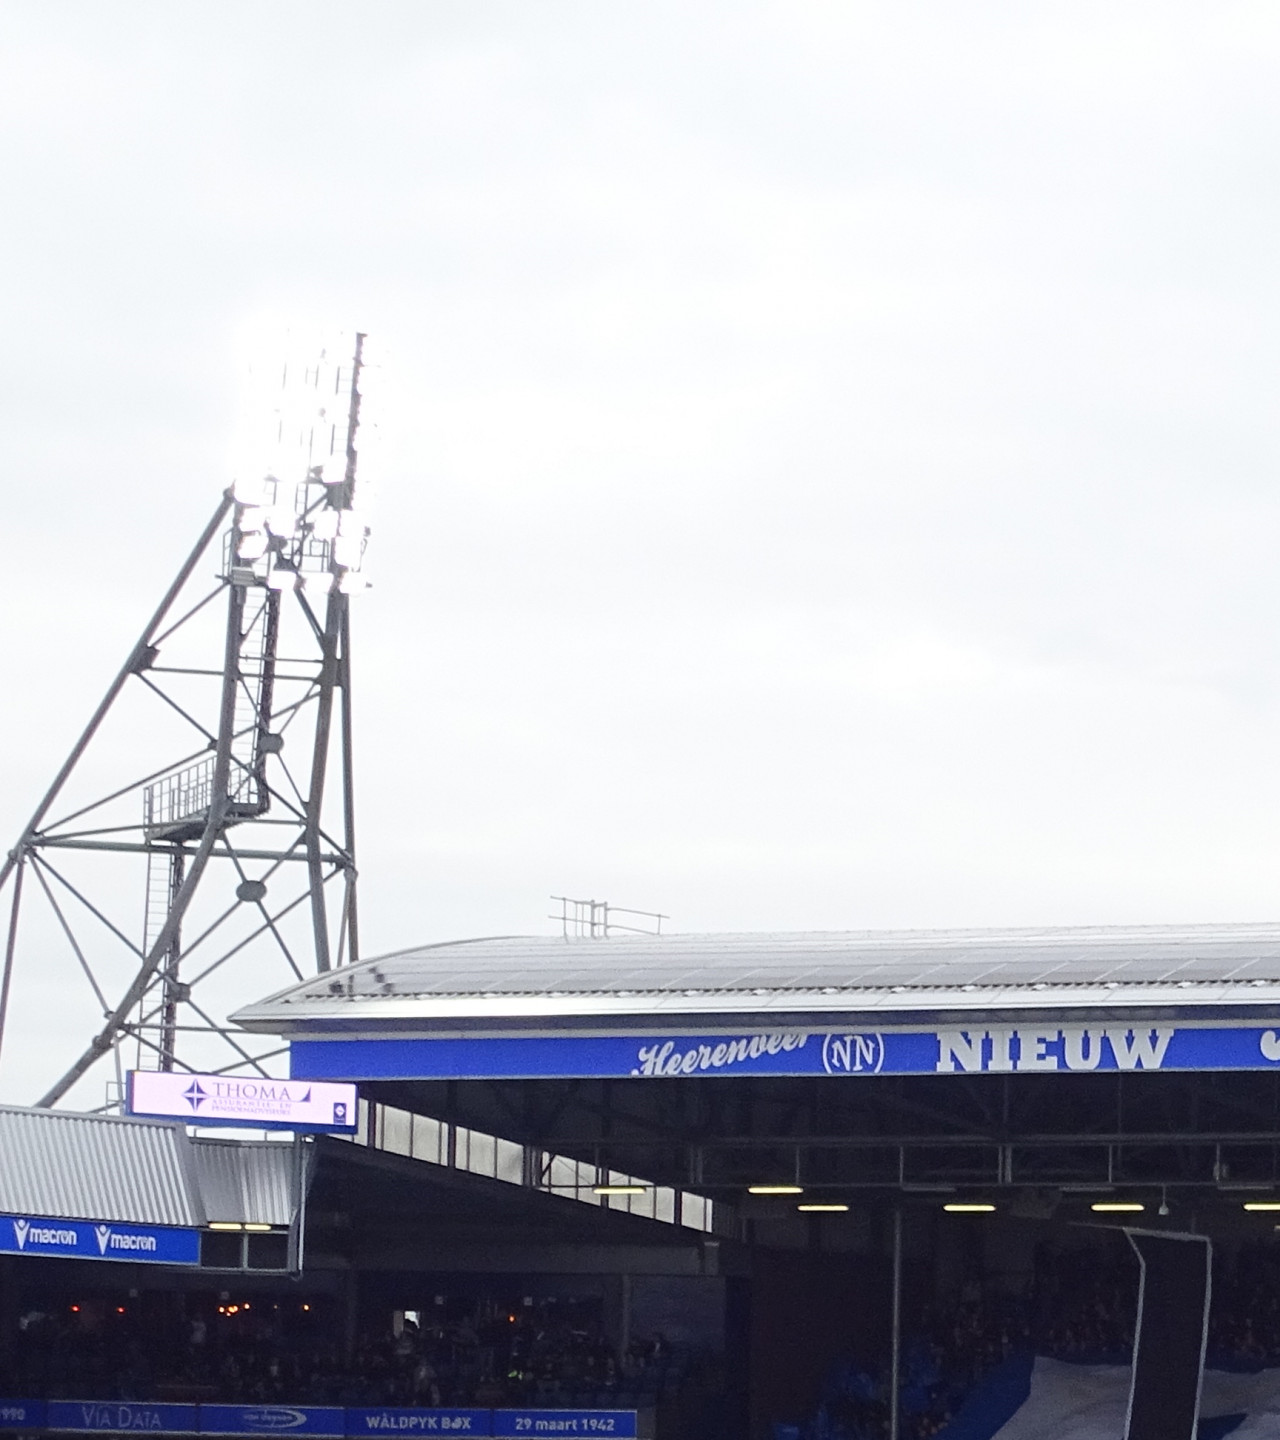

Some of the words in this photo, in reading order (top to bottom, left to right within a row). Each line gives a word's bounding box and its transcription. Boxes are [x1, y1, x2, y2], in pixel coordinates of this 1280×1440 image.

[936, 1029, 1174, 1071] NIEUW
[213, 1082, 292, 1101] THOMA
[30, 1228, 77, 1245] macron
[111, 1233, 156, 1251] macron
[516, 1418, 532, 1431] 29
[535, 1418, 578, 1431] maart
[582, 1418, 615, 1432] 1942
